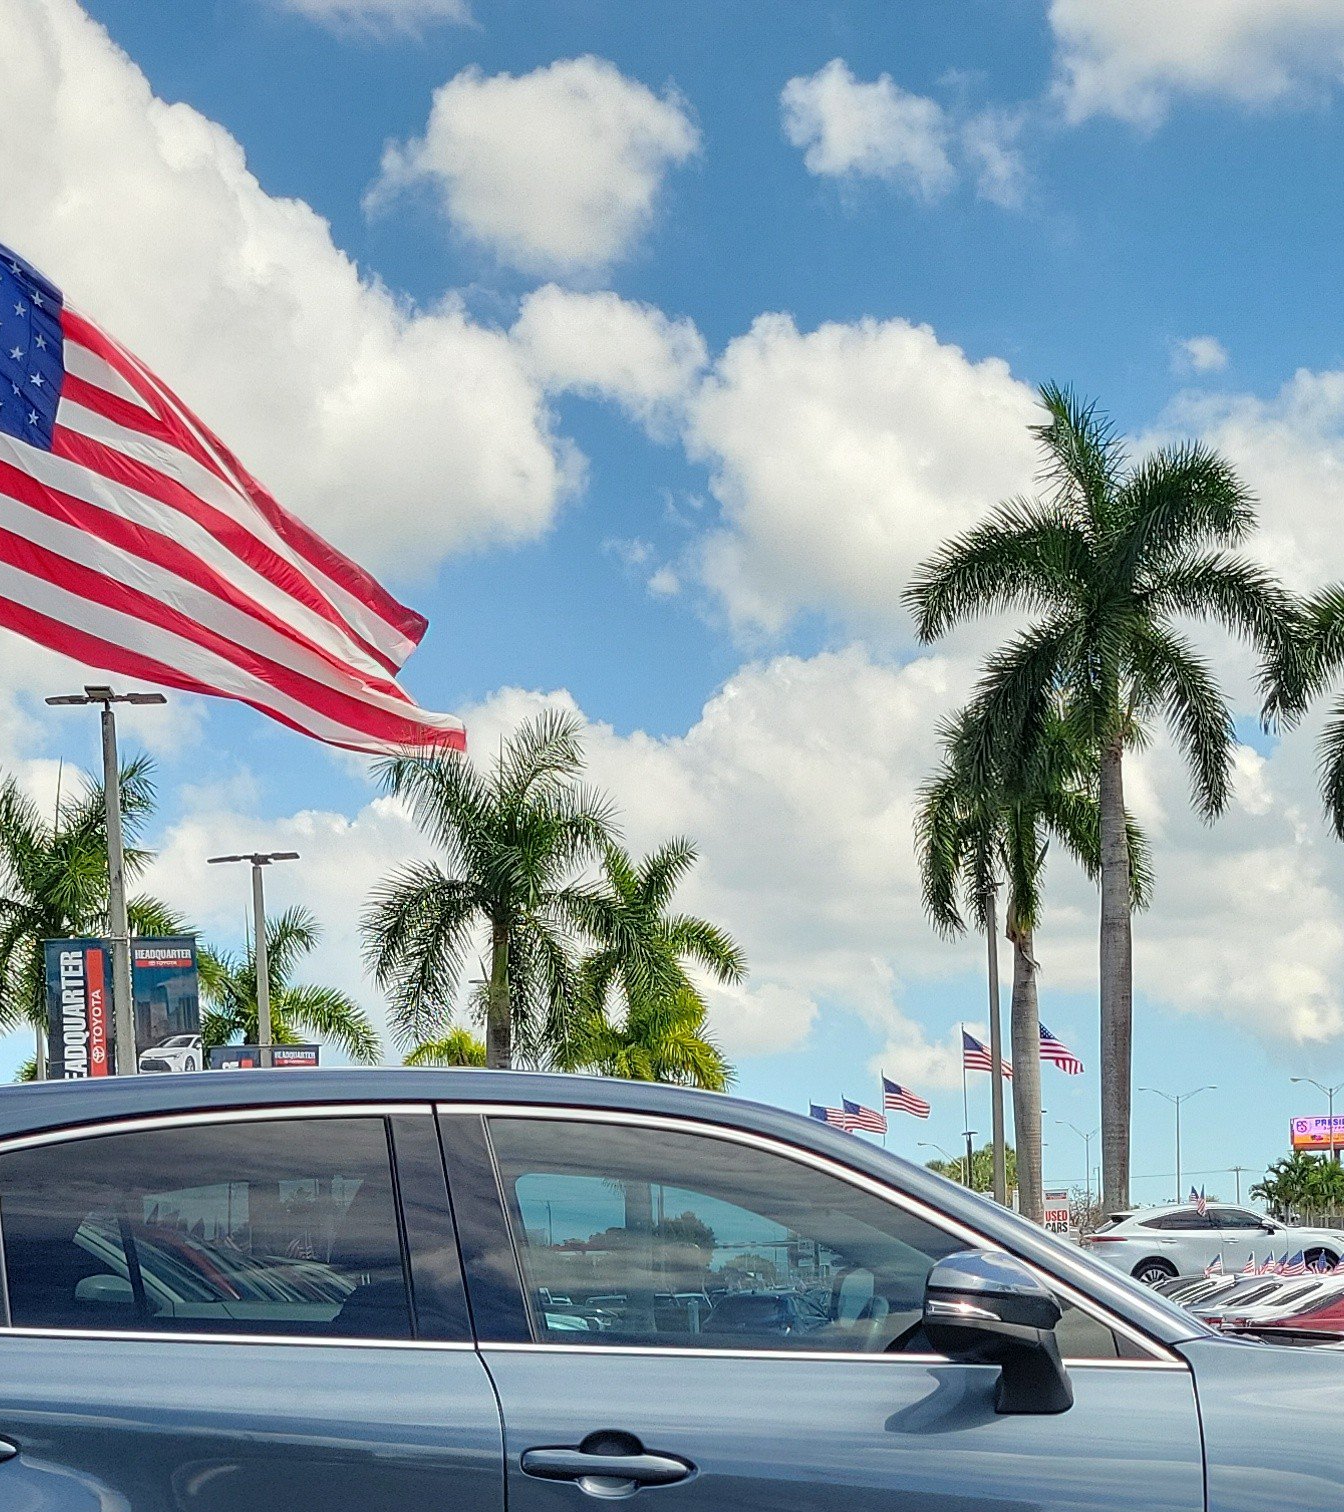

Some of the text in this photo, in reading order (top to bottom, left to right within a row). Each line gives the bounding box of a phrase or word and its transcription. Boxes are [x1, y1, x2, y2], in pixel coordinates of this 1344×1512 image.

[134, 949, 192, 960] HEADQUARTER
[60, 950, 90, 1078] EADQUARTER
[91, 988, 104, 1045] TOYOTA
[1045, 1210, 1068, 1222] USED
[1045, 1222, 1068, 1234] CARS
